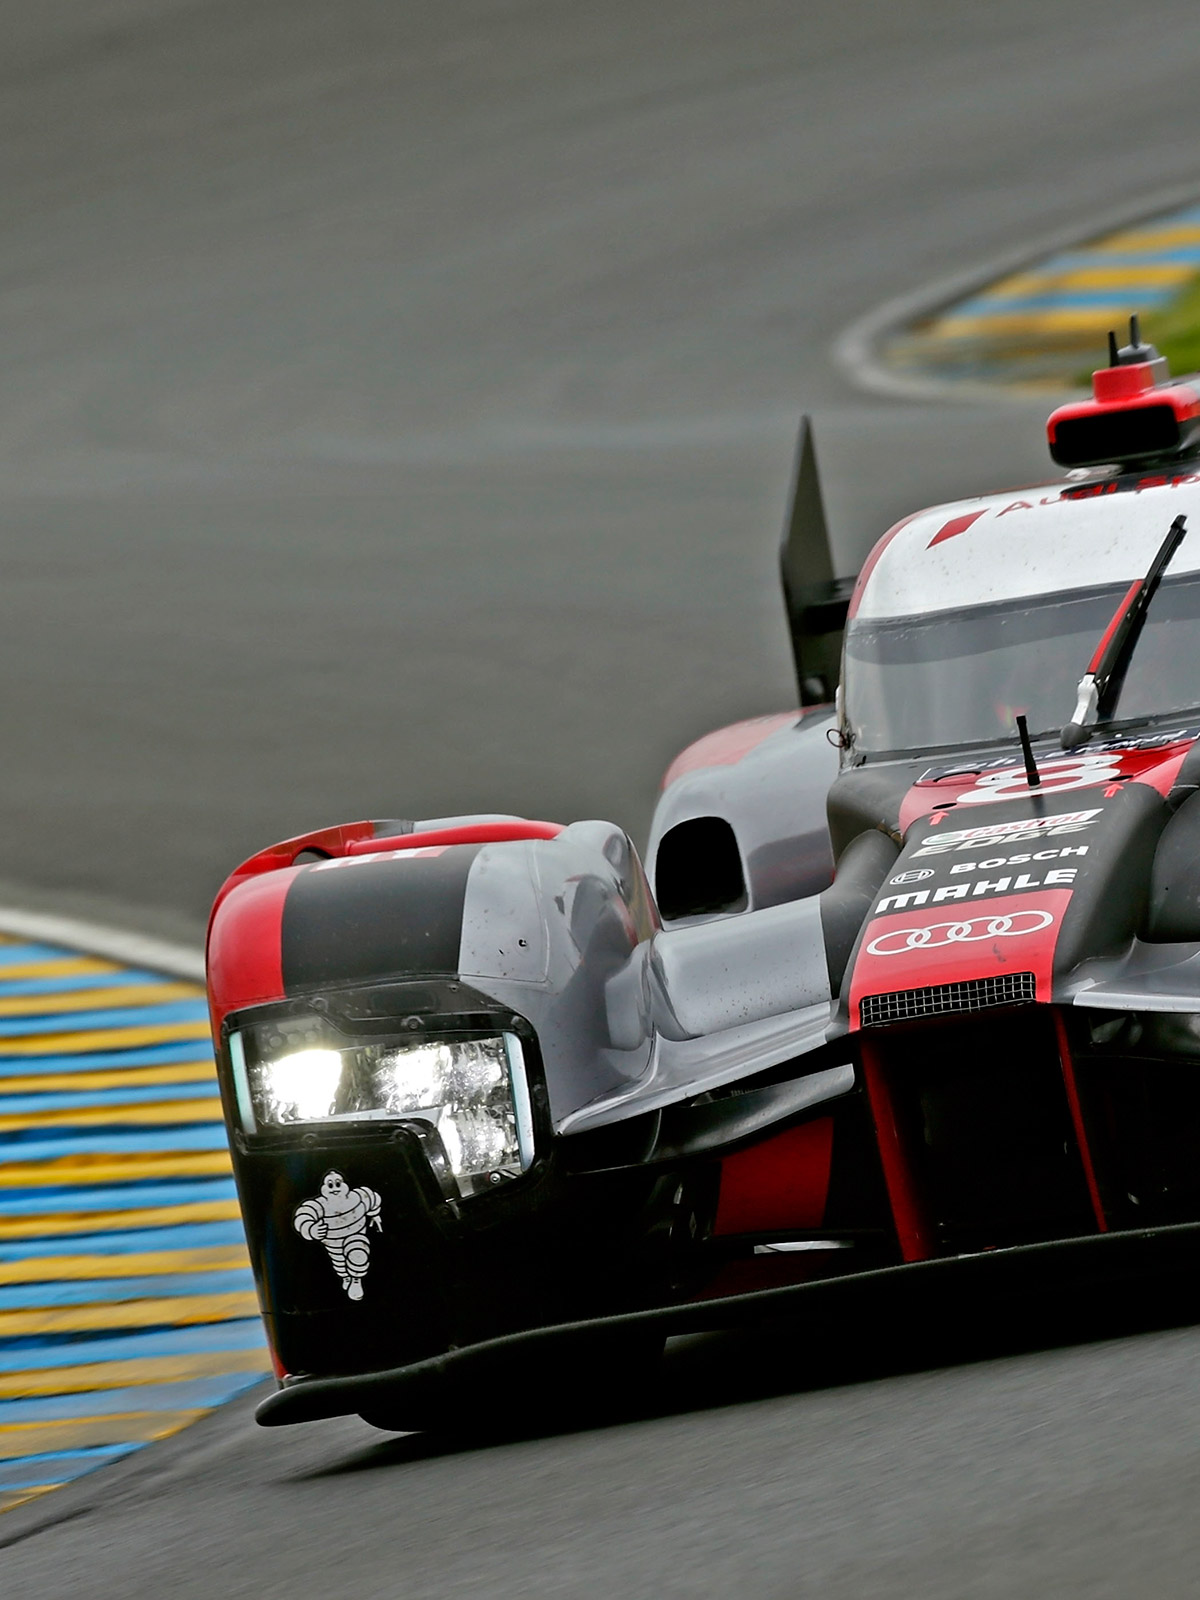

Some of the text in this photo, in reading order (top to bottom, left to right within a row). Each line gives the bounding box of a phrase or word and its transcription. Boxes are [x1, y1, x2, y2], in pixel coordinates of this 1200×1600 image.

[995, 482, 1117, 518] Audi
[956, 754, 1123, 803] 8
[909, 820, 1100, 859] EDGE
[964, 810, 1088, 839] Castrol
[949, 845, 1089, 875] BOSCH
[874, 868, 1078, 914] MAHLE
